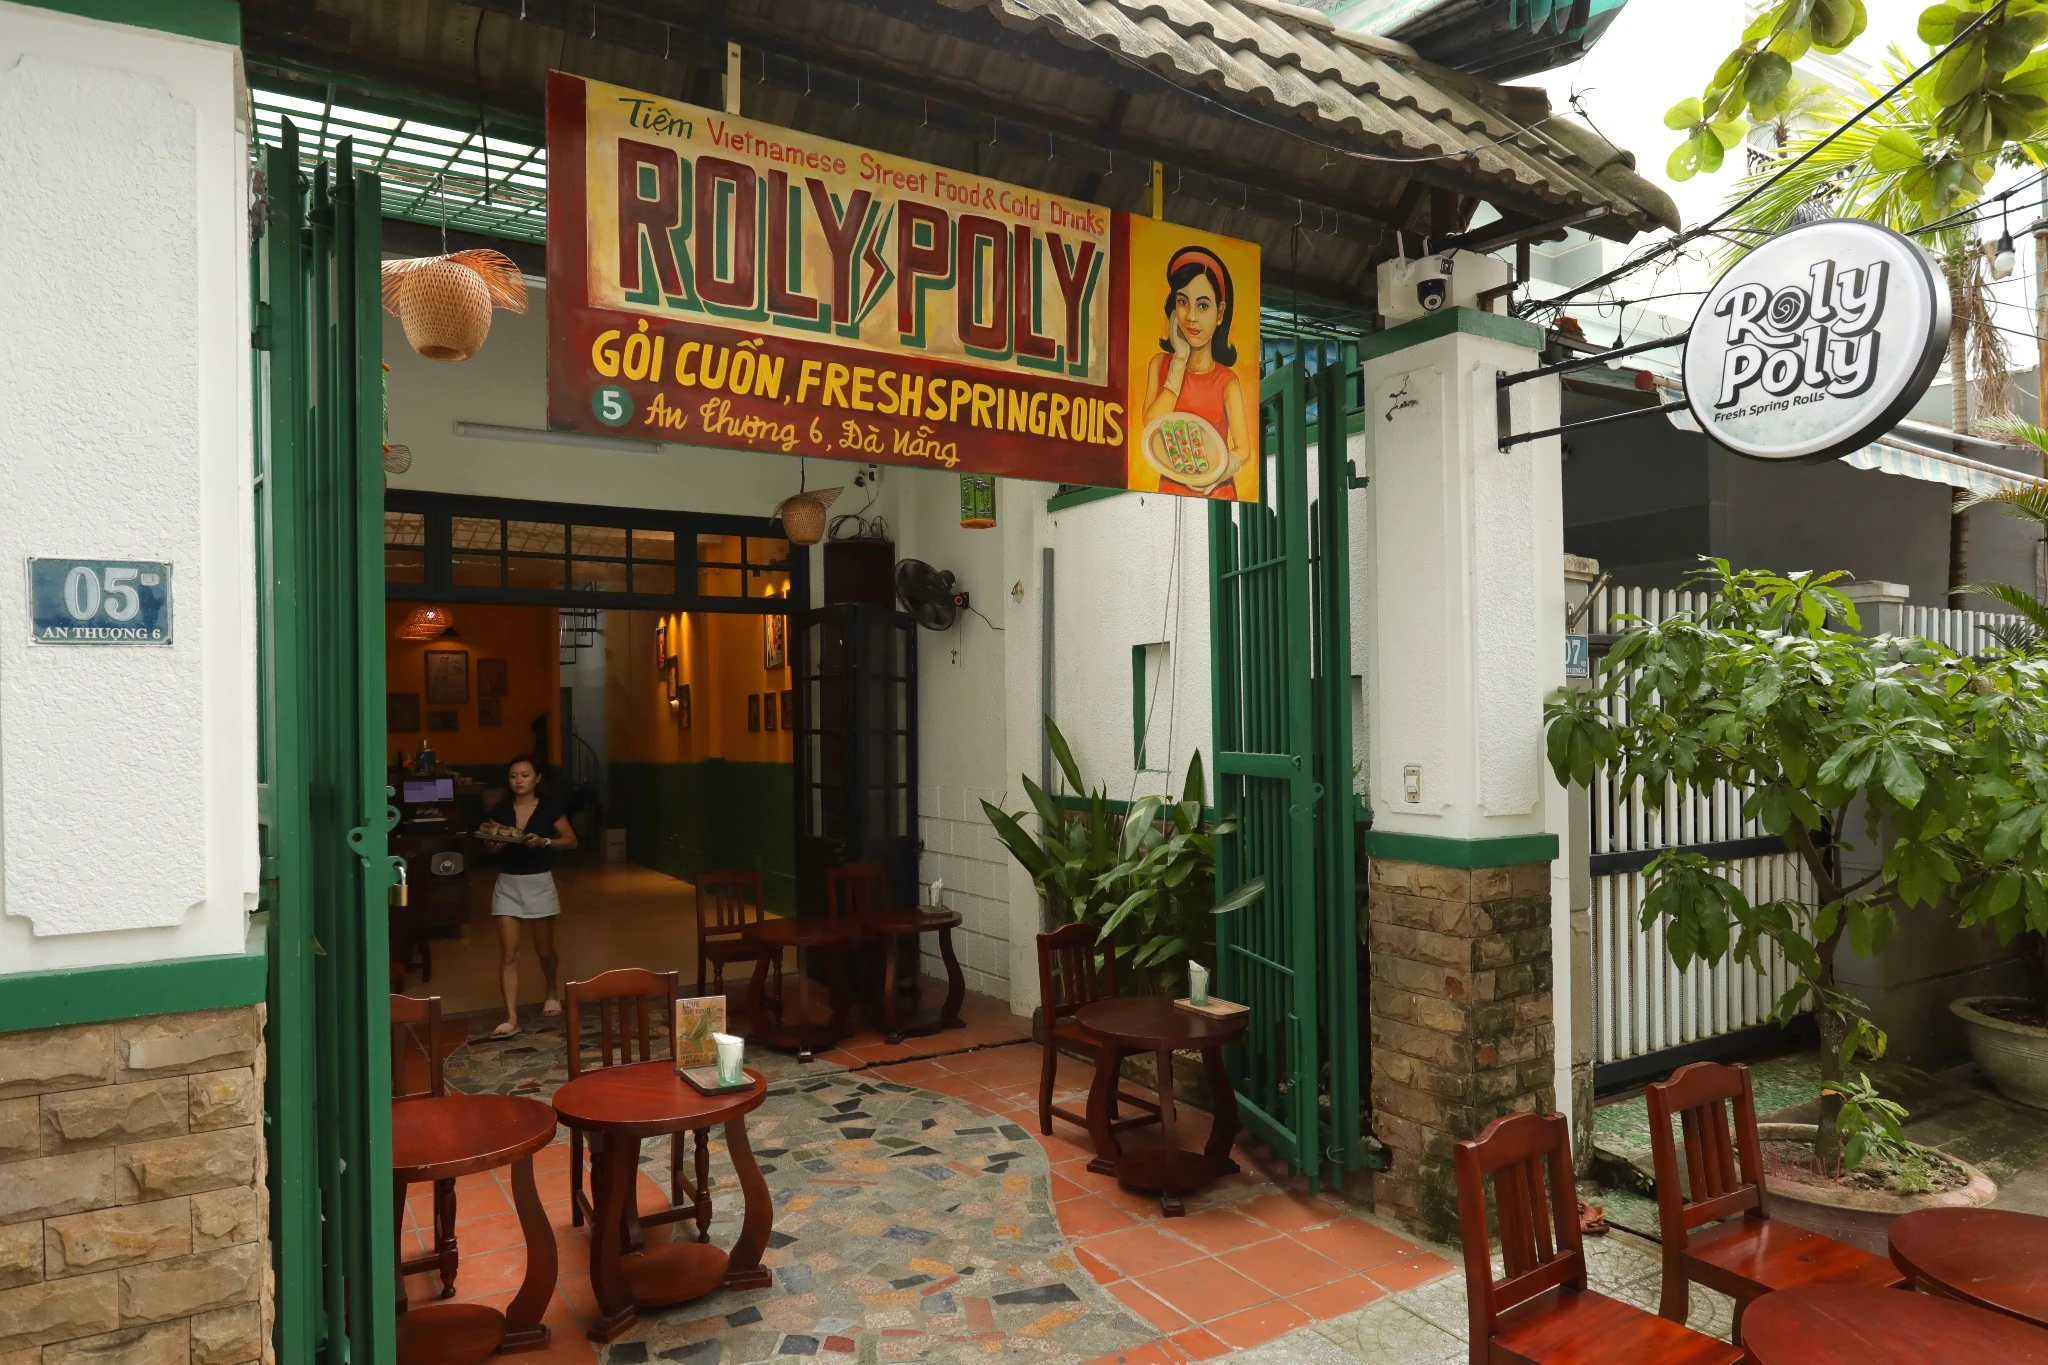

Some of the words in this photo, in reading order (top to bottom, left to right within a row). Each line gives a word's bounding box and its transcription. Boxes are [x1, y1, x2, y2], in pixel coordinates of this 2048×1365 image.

[618, 97, 694, 139] Tiệm
[706, 116, 846, 176] Vietnamese
[860, 152, 928, 193] Street
[1049, 200, 1106, 237] Drinks
[617, 136, 880, 331] ROLY
[897, 198, 1104, 378] POLY
[1714, 258, 1890, 348] Roly
[591, 317, 665, 383] GỎI
[1713, 324, 1881, 409] Poly
[601, 390, 623, 420] 5
[644, 392, 689, 430] An
[838, 419, 885, 454] Đà
[1713, 408, 1747, 422] Fresh
[1748, 399, 1790, 417] Spring
[1792, 391, 1826, 407] Rolls
[63, 566, 140, 622] 05
[42, 626, 69, 639] AN
[151, 628, 161, 640] 6
[682, 1001, 701, 1010] LOVE
